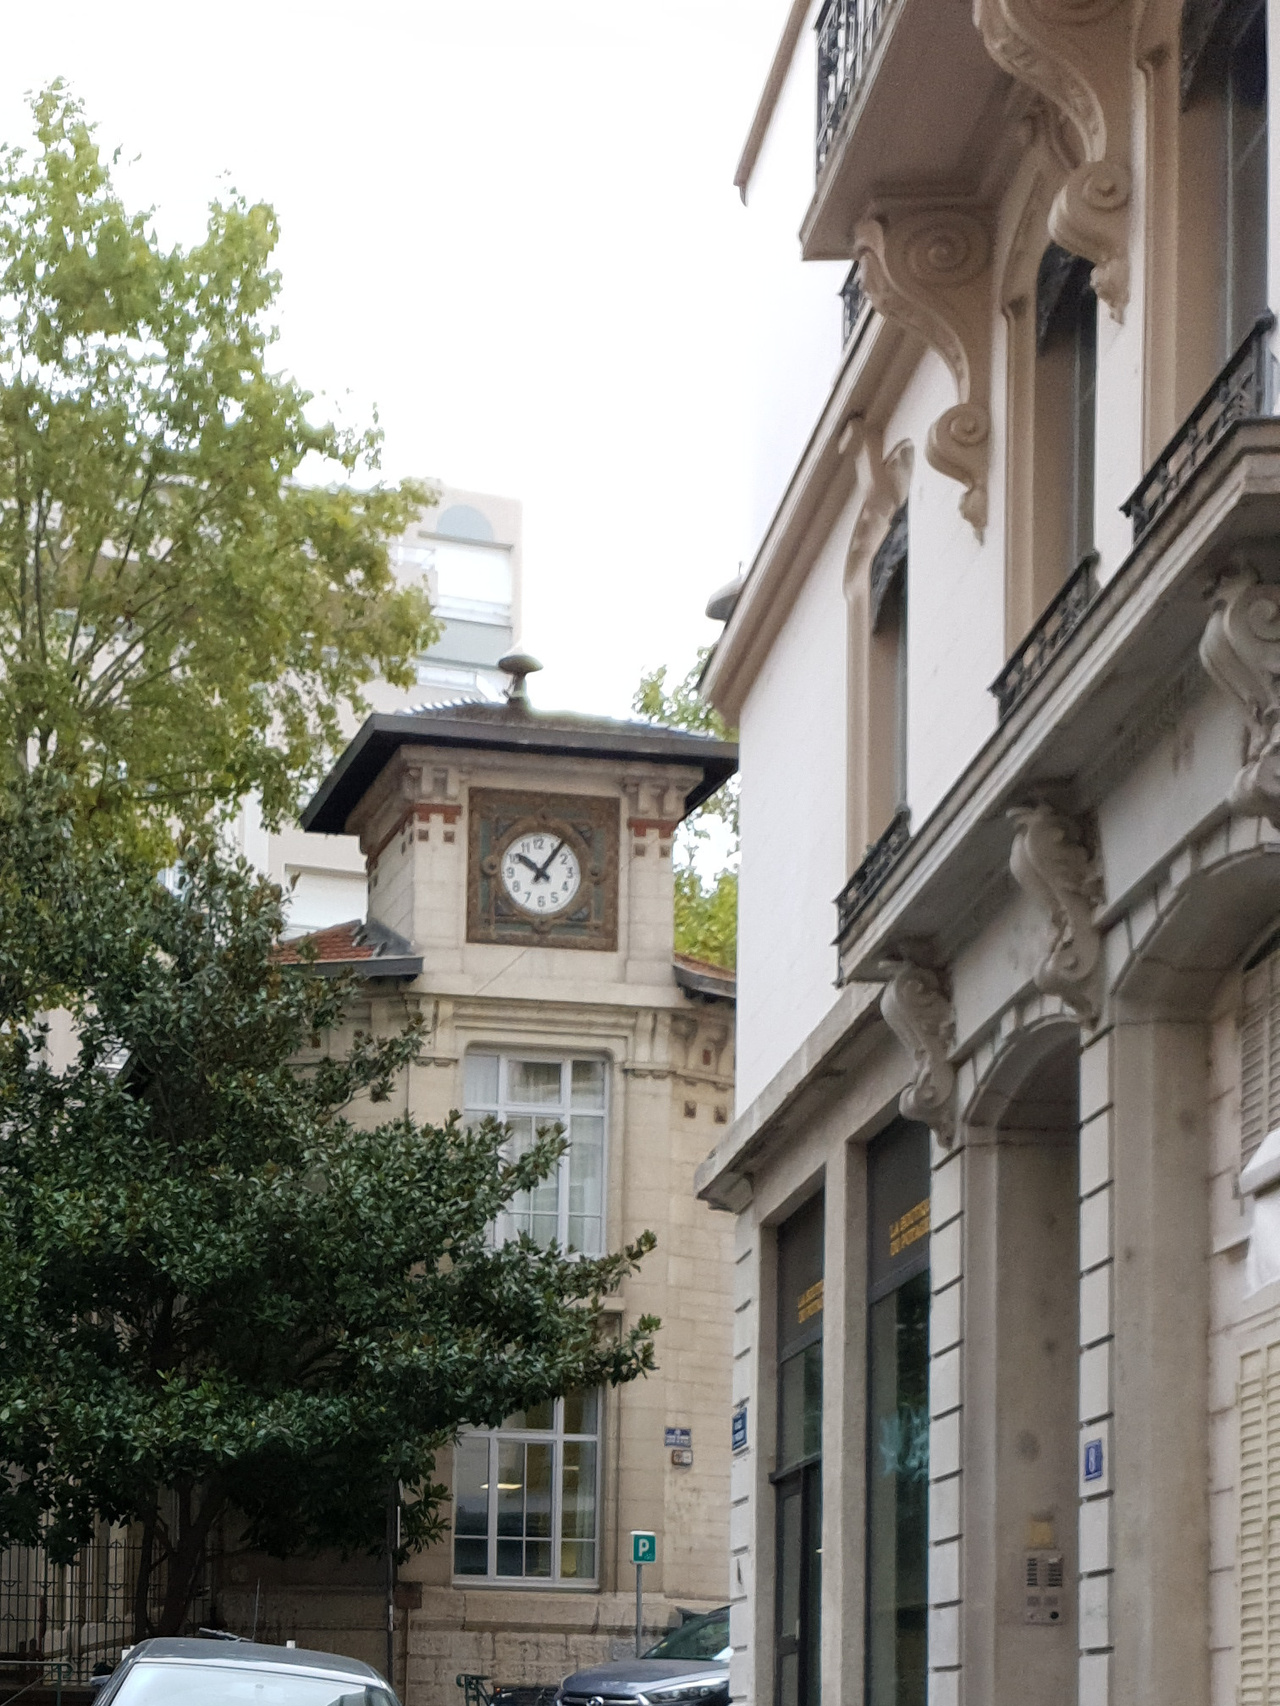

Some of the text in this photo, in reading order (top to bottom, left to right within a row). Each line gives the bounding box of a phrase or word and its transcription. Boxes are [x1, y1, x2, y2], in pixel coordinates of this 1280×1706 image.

[521, 842, 531, 853] 11
[533, 839, 544, 850] 12
[560, 853, 568, 865] 2
[506, 867, 515, 879] 9
[566, 867, 574, 878] 3
[512, 881, 520, 893] 8
[561, 881, 569, 892] 4
[524, 891, 532, 904] 7
[537, 895, 546, 907] 6
[550, 892, 559, 903] 5
[638, 1538, 650, 1557] P
